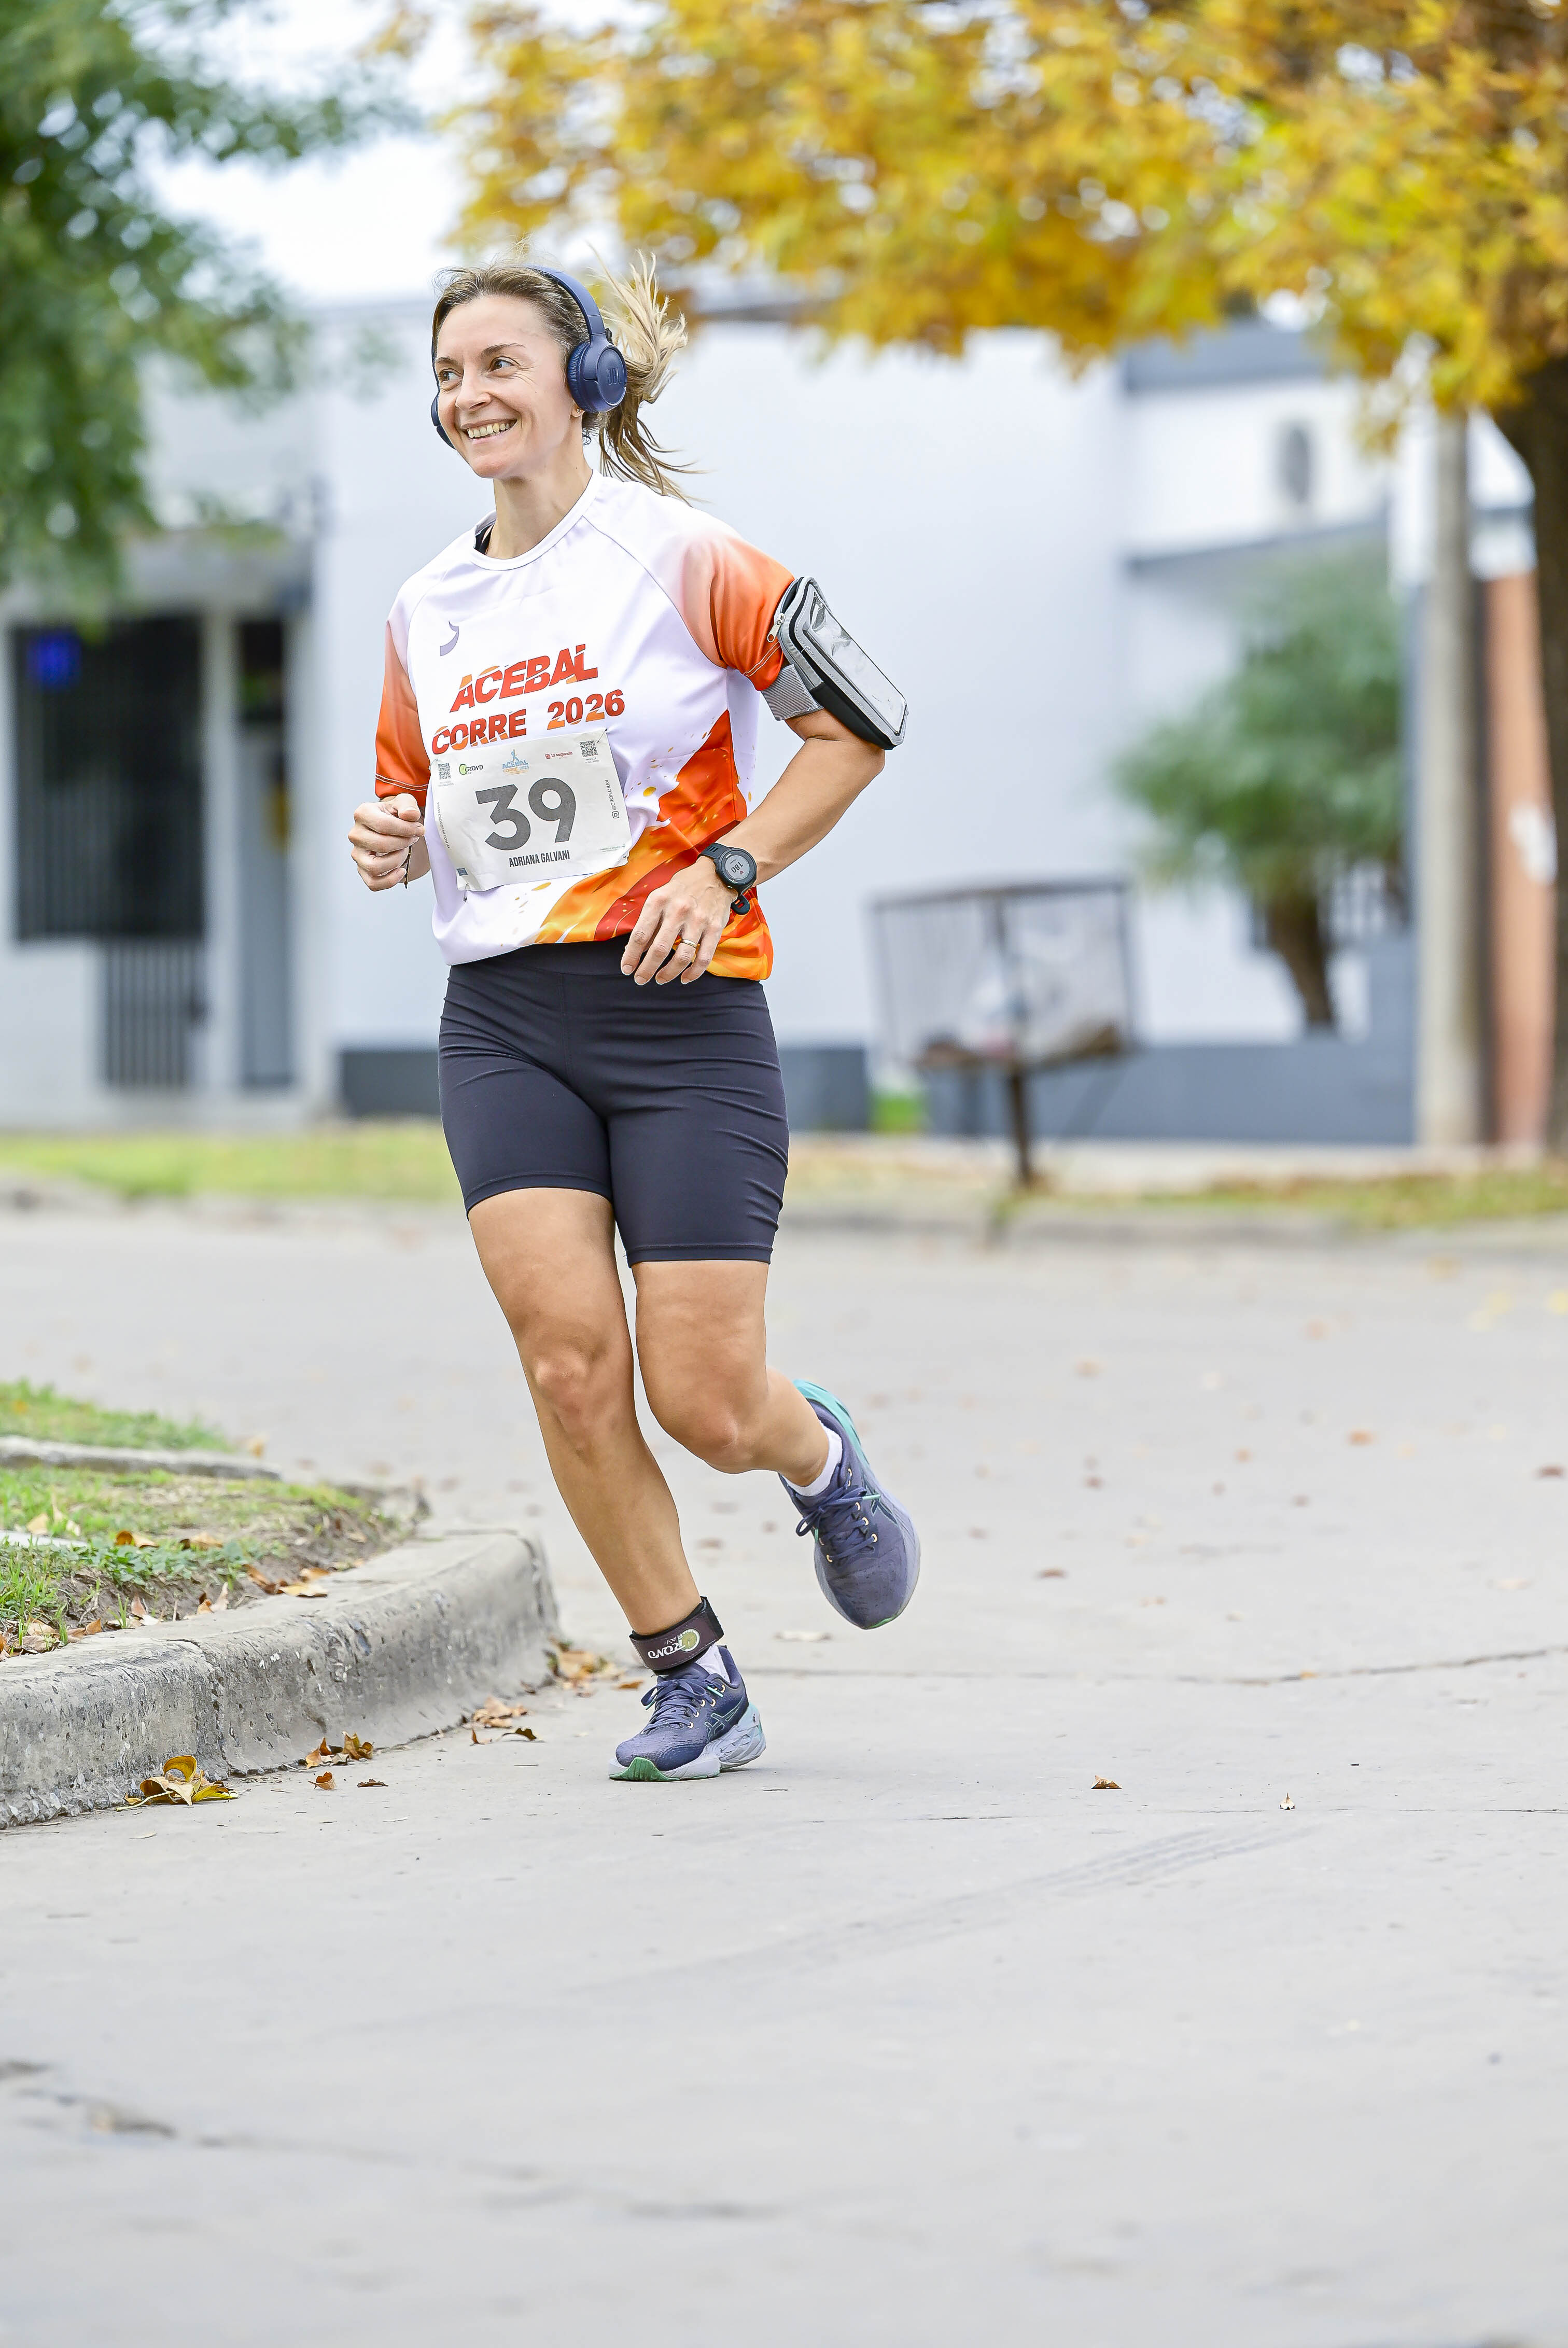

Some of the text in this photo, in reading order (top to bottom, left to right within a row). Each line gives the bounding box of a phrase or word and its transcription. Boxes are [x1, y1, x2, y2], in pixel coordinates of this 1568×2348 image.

[608, 368, 622, 385] JBL
[449, 644, 598, 712] ACEBAL
[432, 689, 625, 754] CORRE 2026
[502, 760, 528, 769] ACEBAL
[605, 779, 617, 810] @CRONORAV
[475, 777, 576, 850] 39
[509, 849, 570, 867] ADRIANA GALVANI
[731, 862, 743, 873] 180
[666, 1633, 683, 1645] RAV
